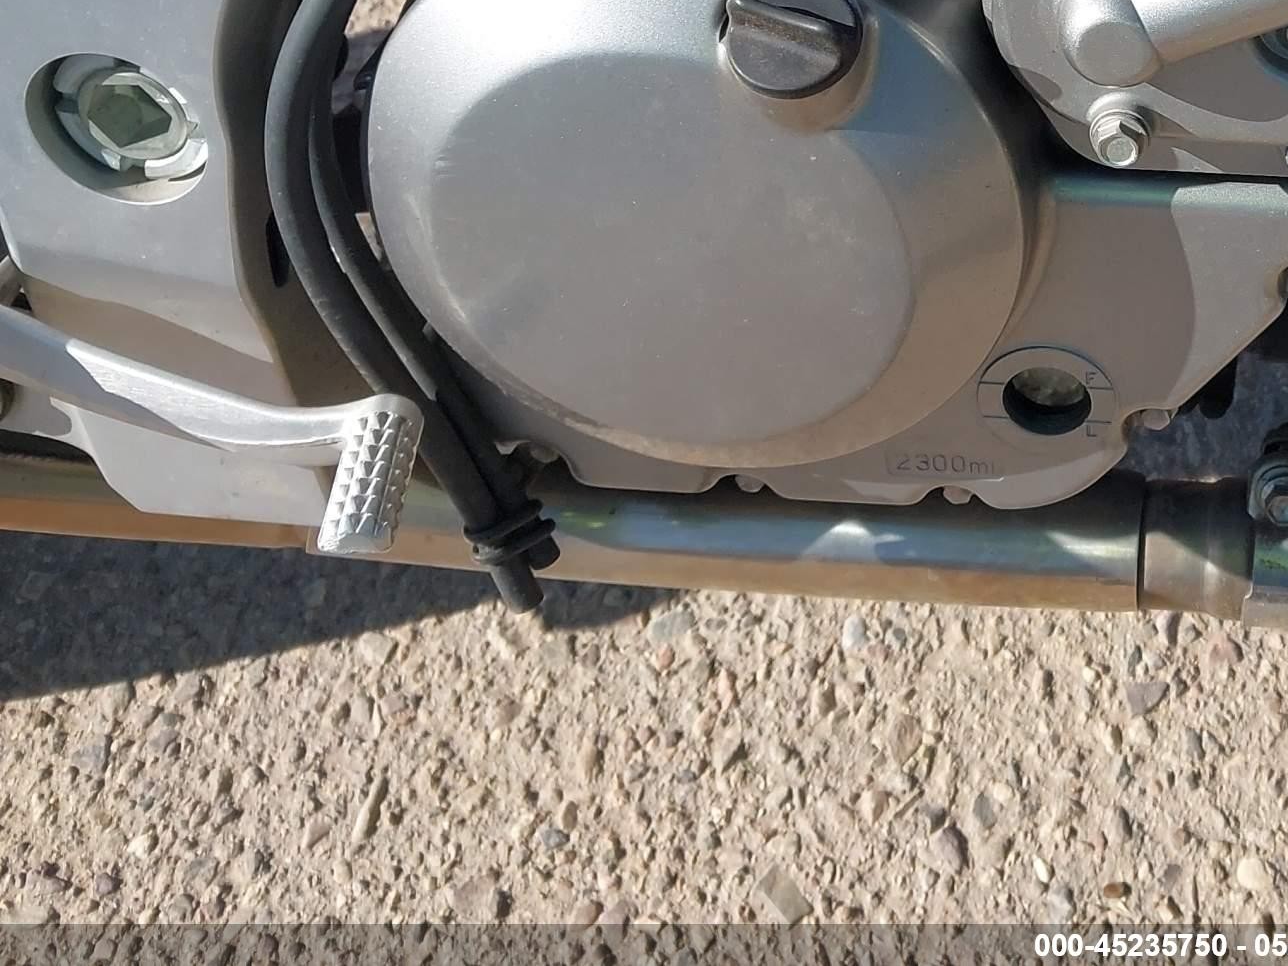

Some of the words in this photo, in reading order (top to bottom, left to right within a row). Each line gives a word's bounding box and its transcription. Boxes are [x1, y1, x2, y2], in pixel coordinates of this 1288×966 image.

[1085, 371, 1097, 385] F
[1086, 424, 1097, 437] L
[896, 453, 995, 475] 2300ml
